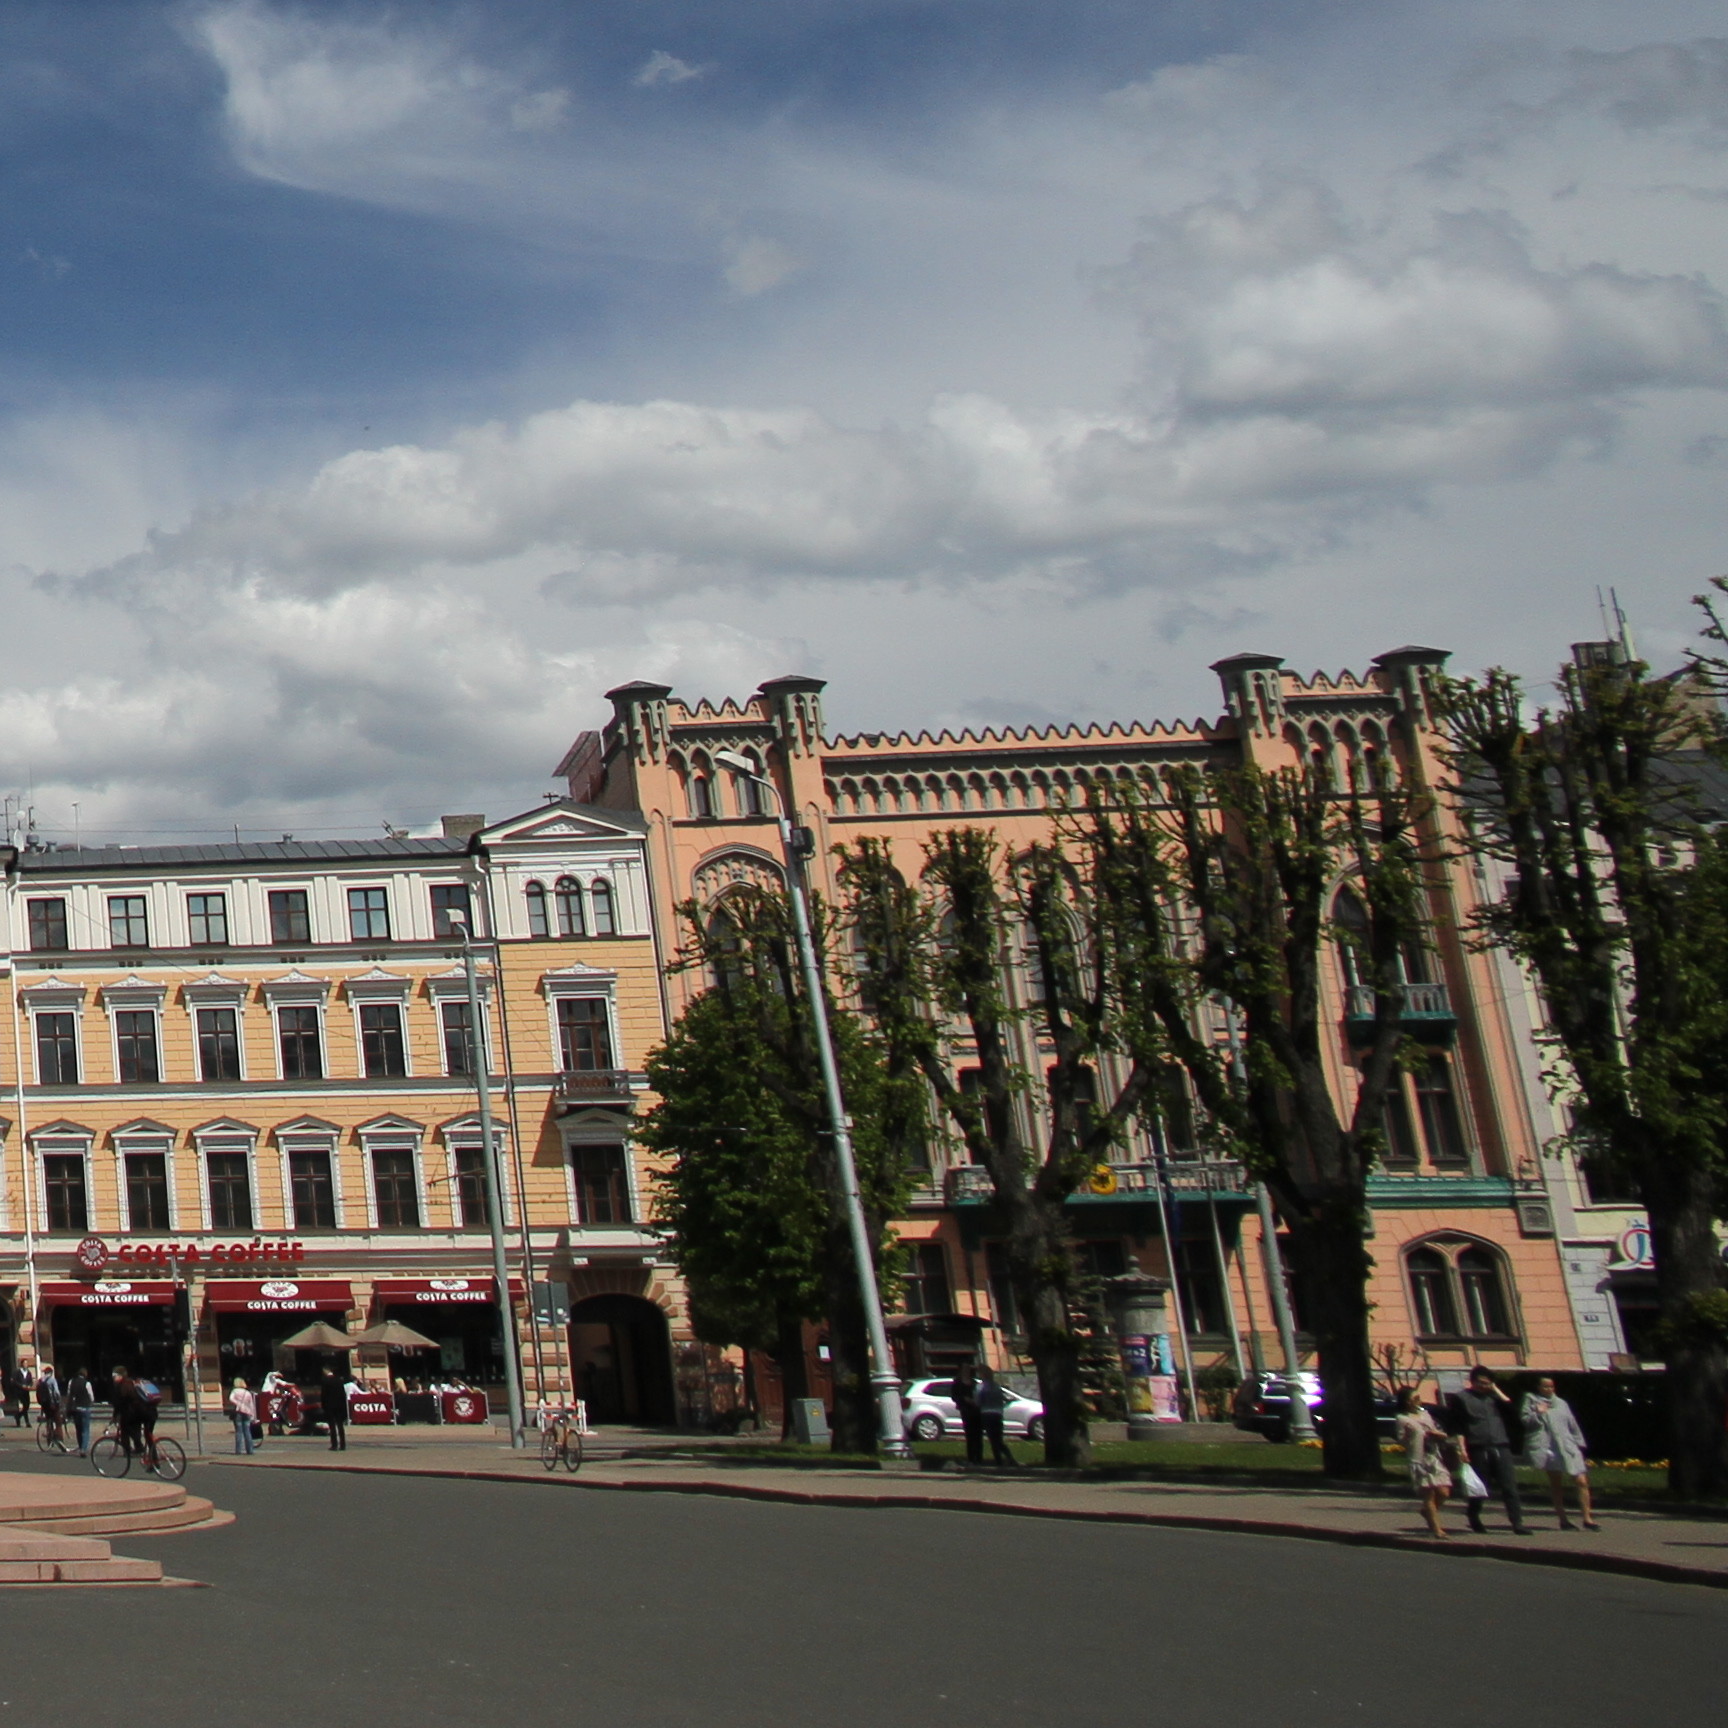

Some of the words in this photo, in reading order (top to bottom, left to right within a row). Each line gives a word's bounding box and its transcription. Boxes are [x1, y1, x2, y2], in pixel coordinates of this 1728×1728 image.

[118, 1243, 201, 1267] COSTA
[210, 1242, 305, 1264] COFFEE
[81, 1295, 112, 1304] COSTA
[114, 1294, 150, 1303] COFFEE
[416, 1292, 447, 1302] COSTA
[450, 1292, 486, 1300] COFFEE
[247, 1301, 278, 1310] COSTA
[281, 1300, 317, 1309] COFFEE
[353, 1403, 387, 1413] COSTA
